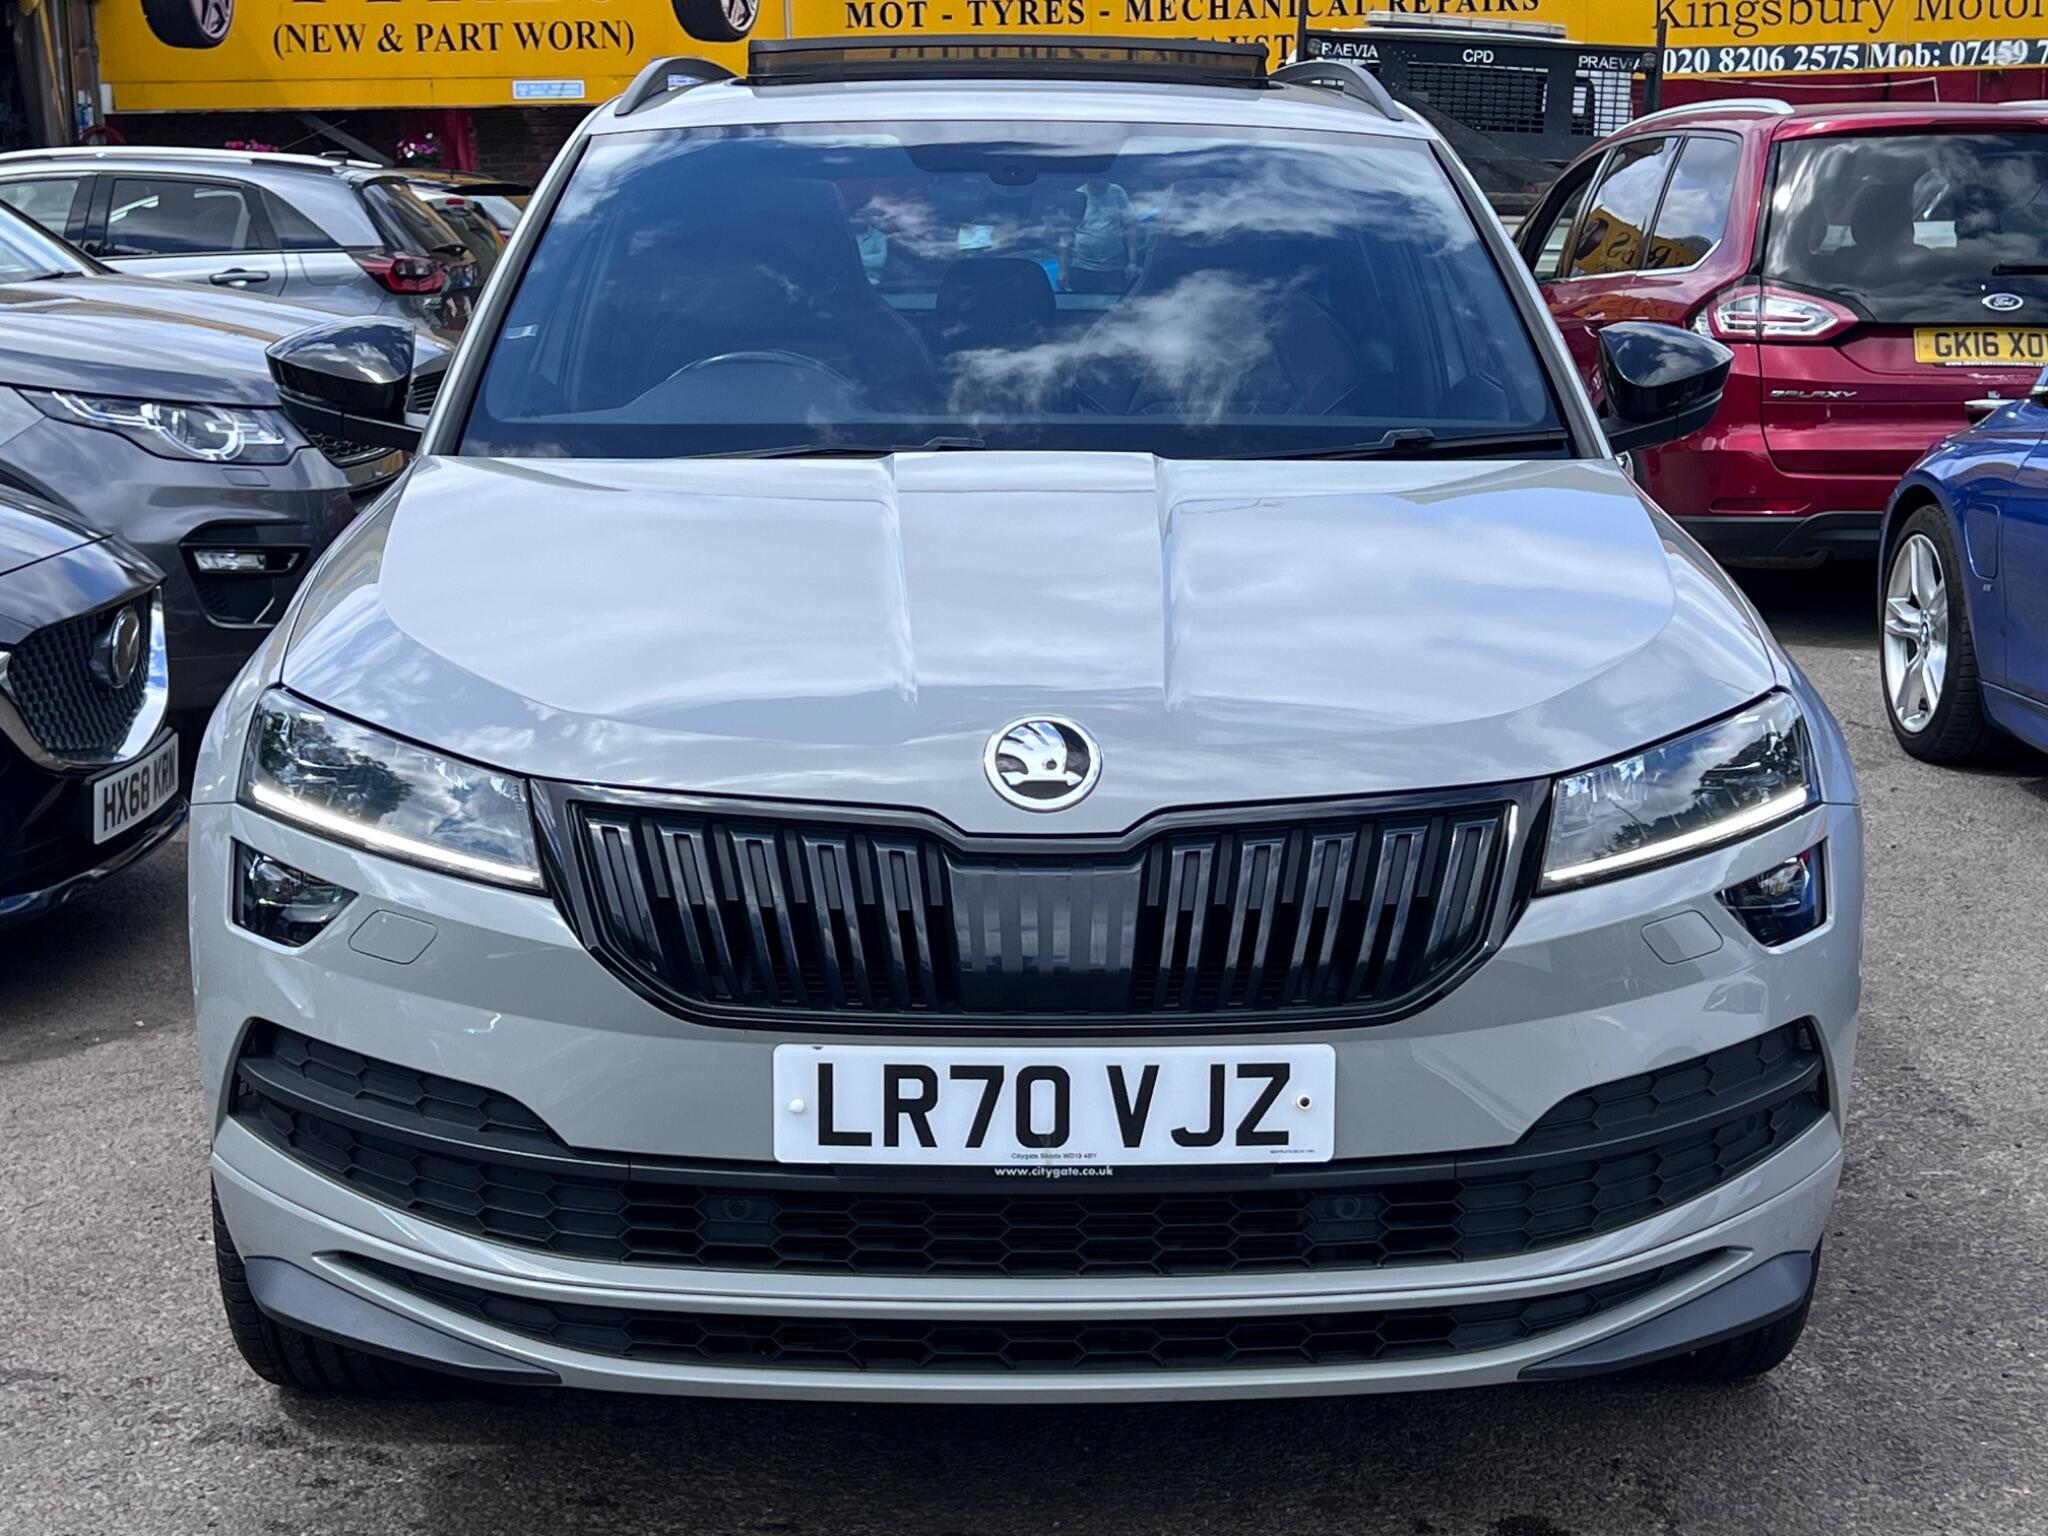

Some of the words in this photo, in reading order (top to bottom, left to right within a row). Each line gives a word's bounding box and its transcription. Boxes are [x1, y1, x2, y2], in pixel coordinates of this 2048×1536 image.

[845, 1, 927, 28] MOT
[967, 0, 1085, 26] TYRES
[1651, 0, 1895, 38] Kingsbury
[273, 23, 367, 60] (NEW
[377, 22, 404, 52] &
[415, 23, 503, 52] PART
[513, 20, 635, 56] WORN)
[1462, 49, 1495, 64] CPD
[1662, 49, 1710, 74] 020
[1718, 46, 1785, 73] 8206
[1793, 45, 1860, 71] 2575
[1869, 42, 1941, 68] Mob:
[1934, 332, 2000, 357] GK16
[2007, 332, 2048, 358] XO
[1769, 389, 1858, 399] GALAXY
[103, 766, 150, 832] HX68
[817, 1062, 1071, 1149] LR70
[1106, 1062, 1292, 1148] VJZ
[993, 1165, 1114, 1179] www.citygate.co.uk
